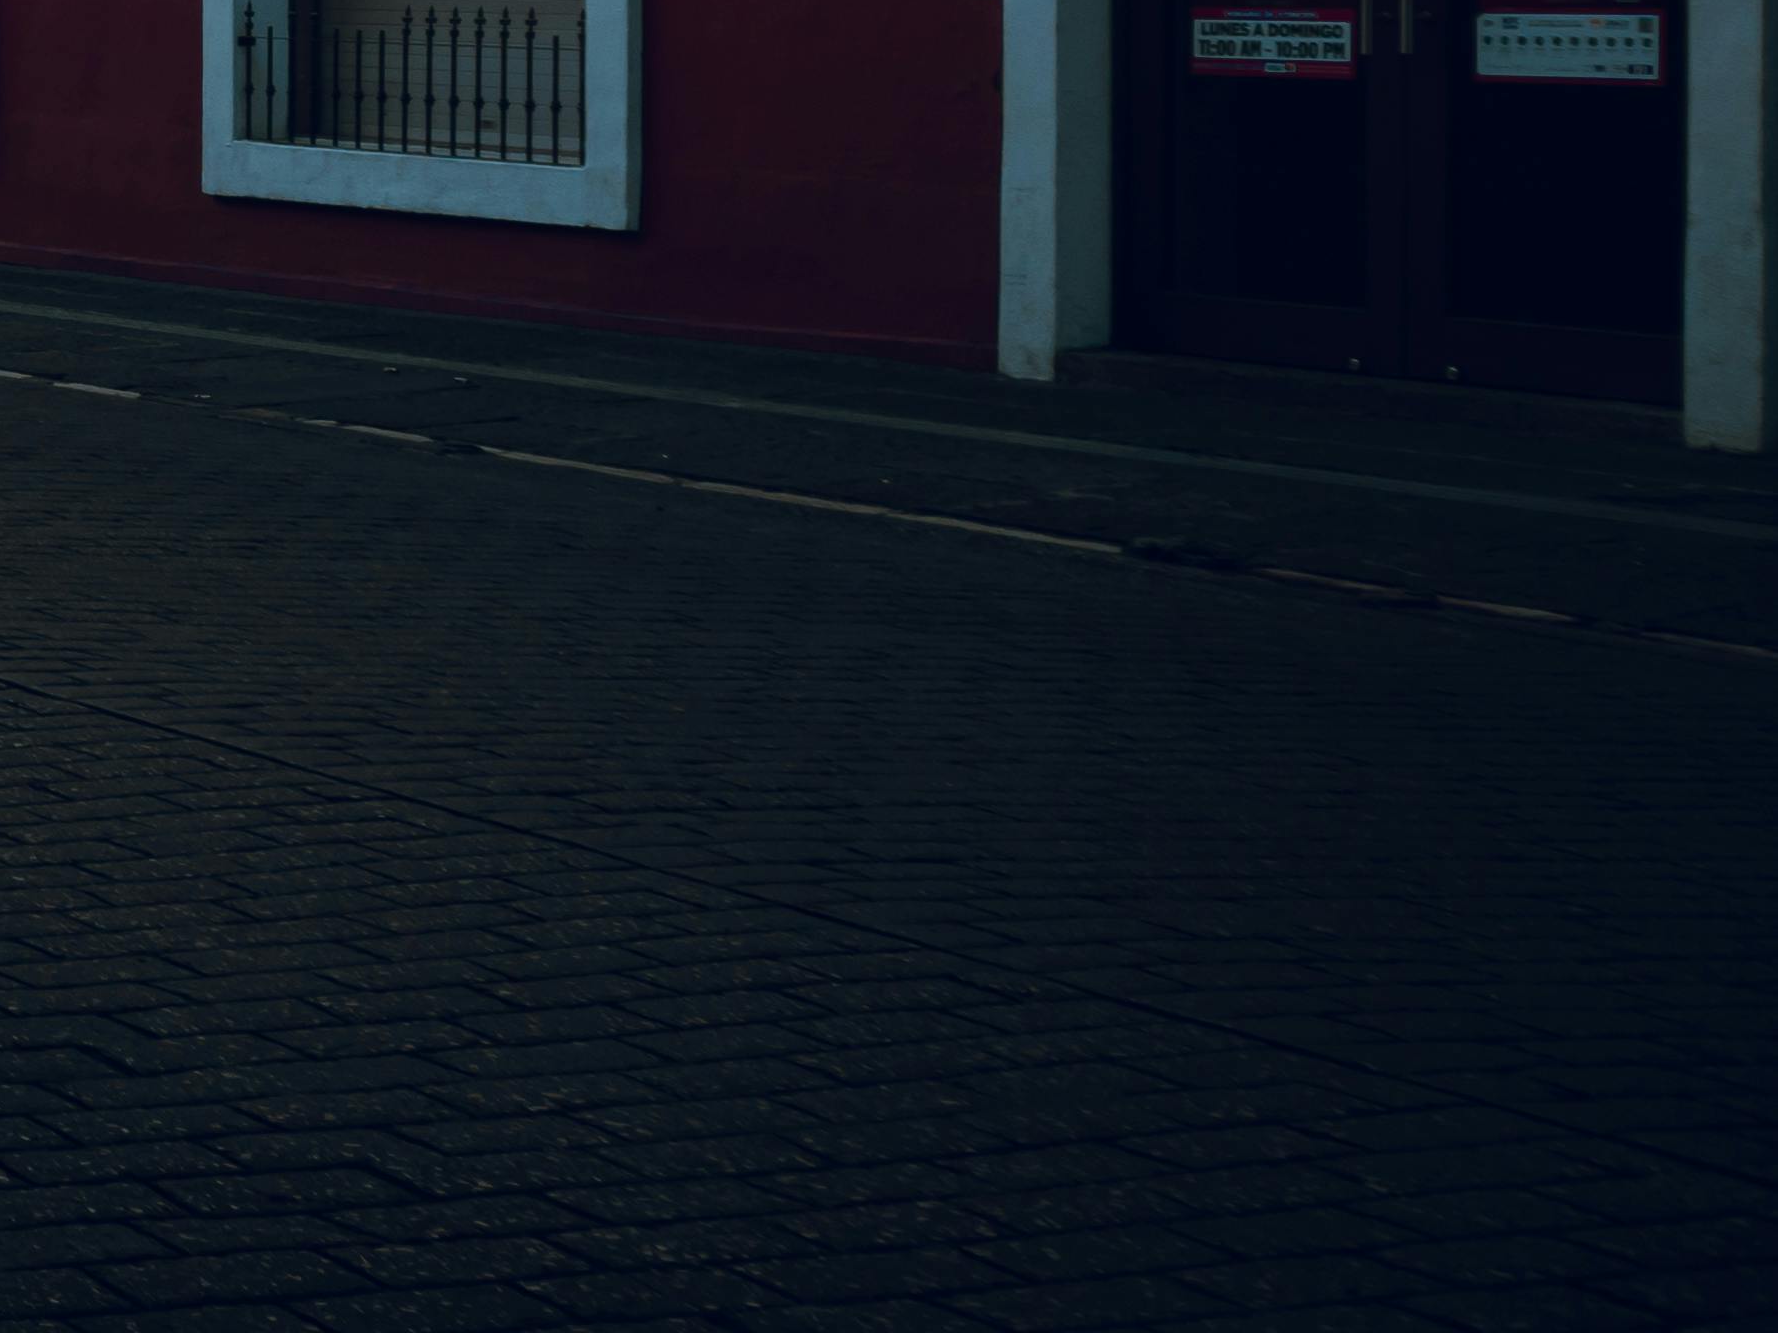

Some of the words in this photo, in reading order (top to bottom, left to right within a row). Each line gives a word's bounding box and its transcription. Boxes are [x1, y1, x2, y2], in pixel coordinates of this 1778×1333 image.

[1200, 22, 1250, 36] LUNES
[1253, 23, 1264, 36] A
[1268, 23, 1344, 38] DOMINGO
[1199, 40, 1236, 56] 11:00
[1240, 40, 1262, 56] AM
[1275, 41, 1319, 58] 10:00
[1323, 42, 1346, 59] PM
